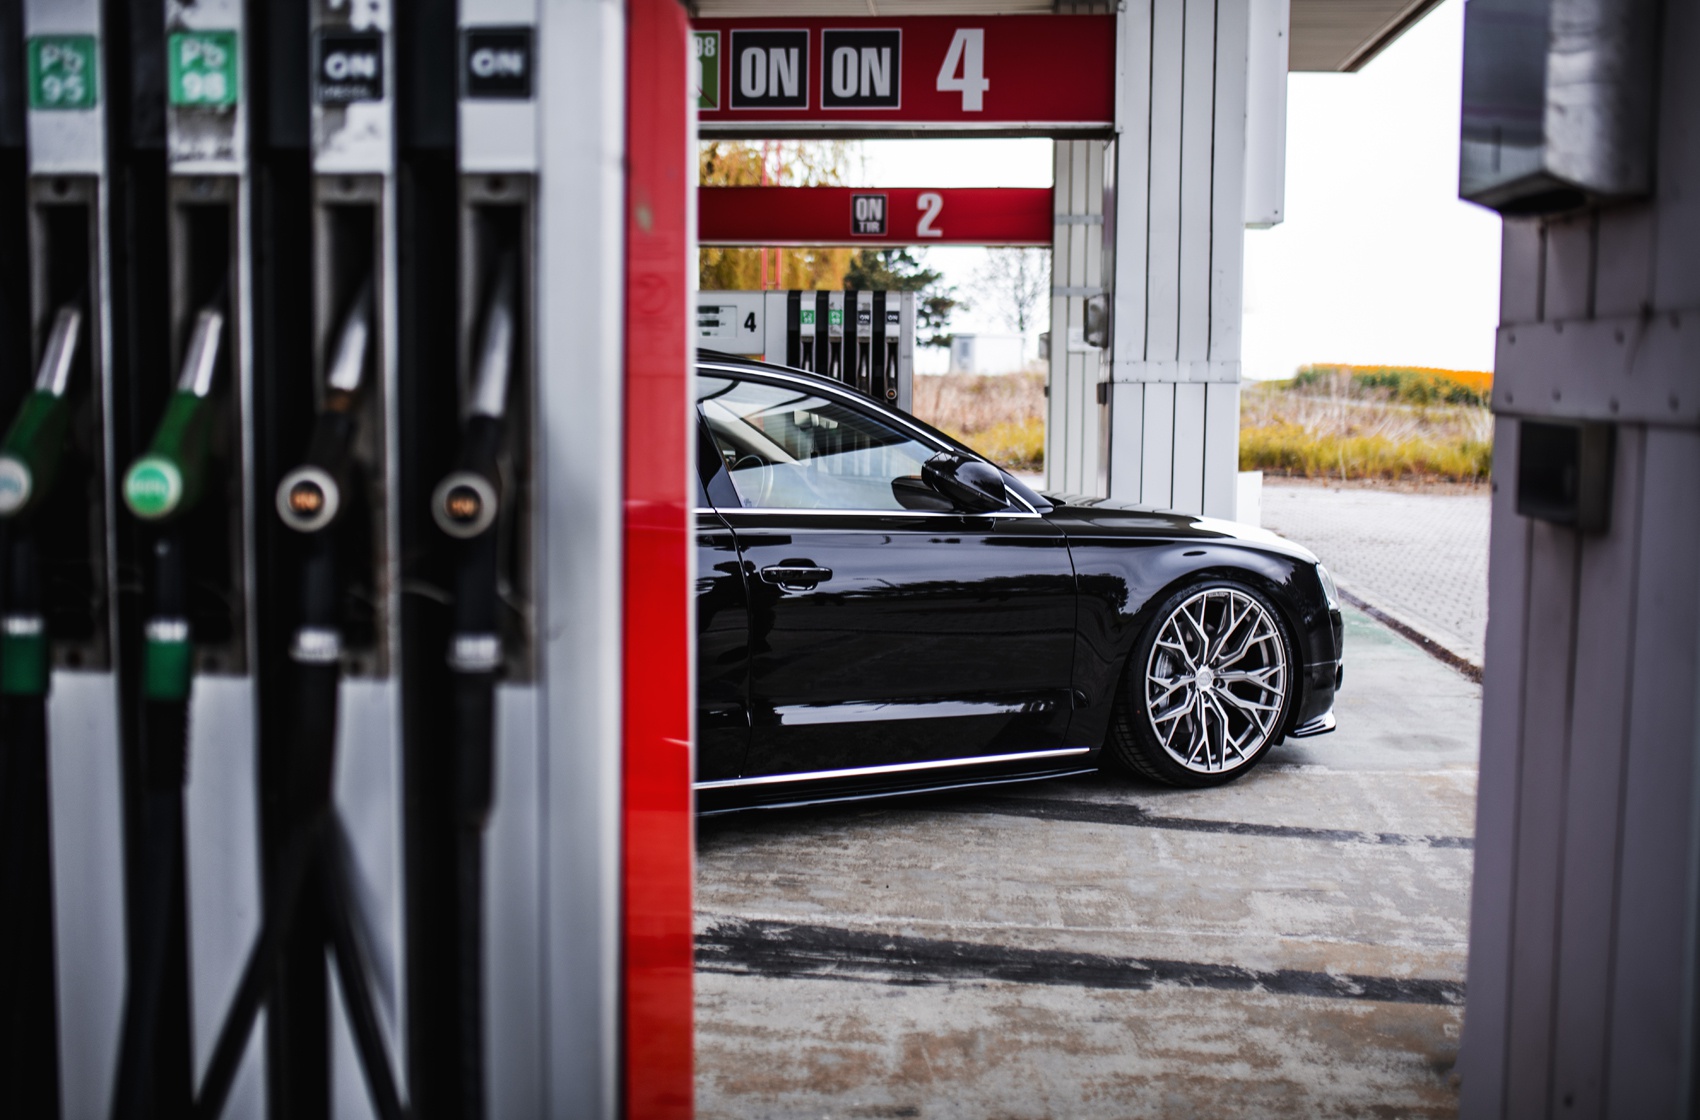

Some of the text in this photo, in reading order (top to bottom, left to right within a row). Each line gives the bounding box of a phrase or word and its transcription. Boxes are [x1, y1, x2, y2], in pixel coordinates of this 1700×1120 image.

[41, 43, 84, 74] Pb
[324, 51, 377, 80] ON
[471, 47, 523, 77] ON
[740, 47, 800, 97] ON
[832, 47, 892, 97] ON
[936, 28, 990, 112] 4
[42, 74, 84, 103] 95
[855, 192, 944, 238] ON 2
[859, 221, 880, 234] TIR
[743, 311, 757, 333] 4
